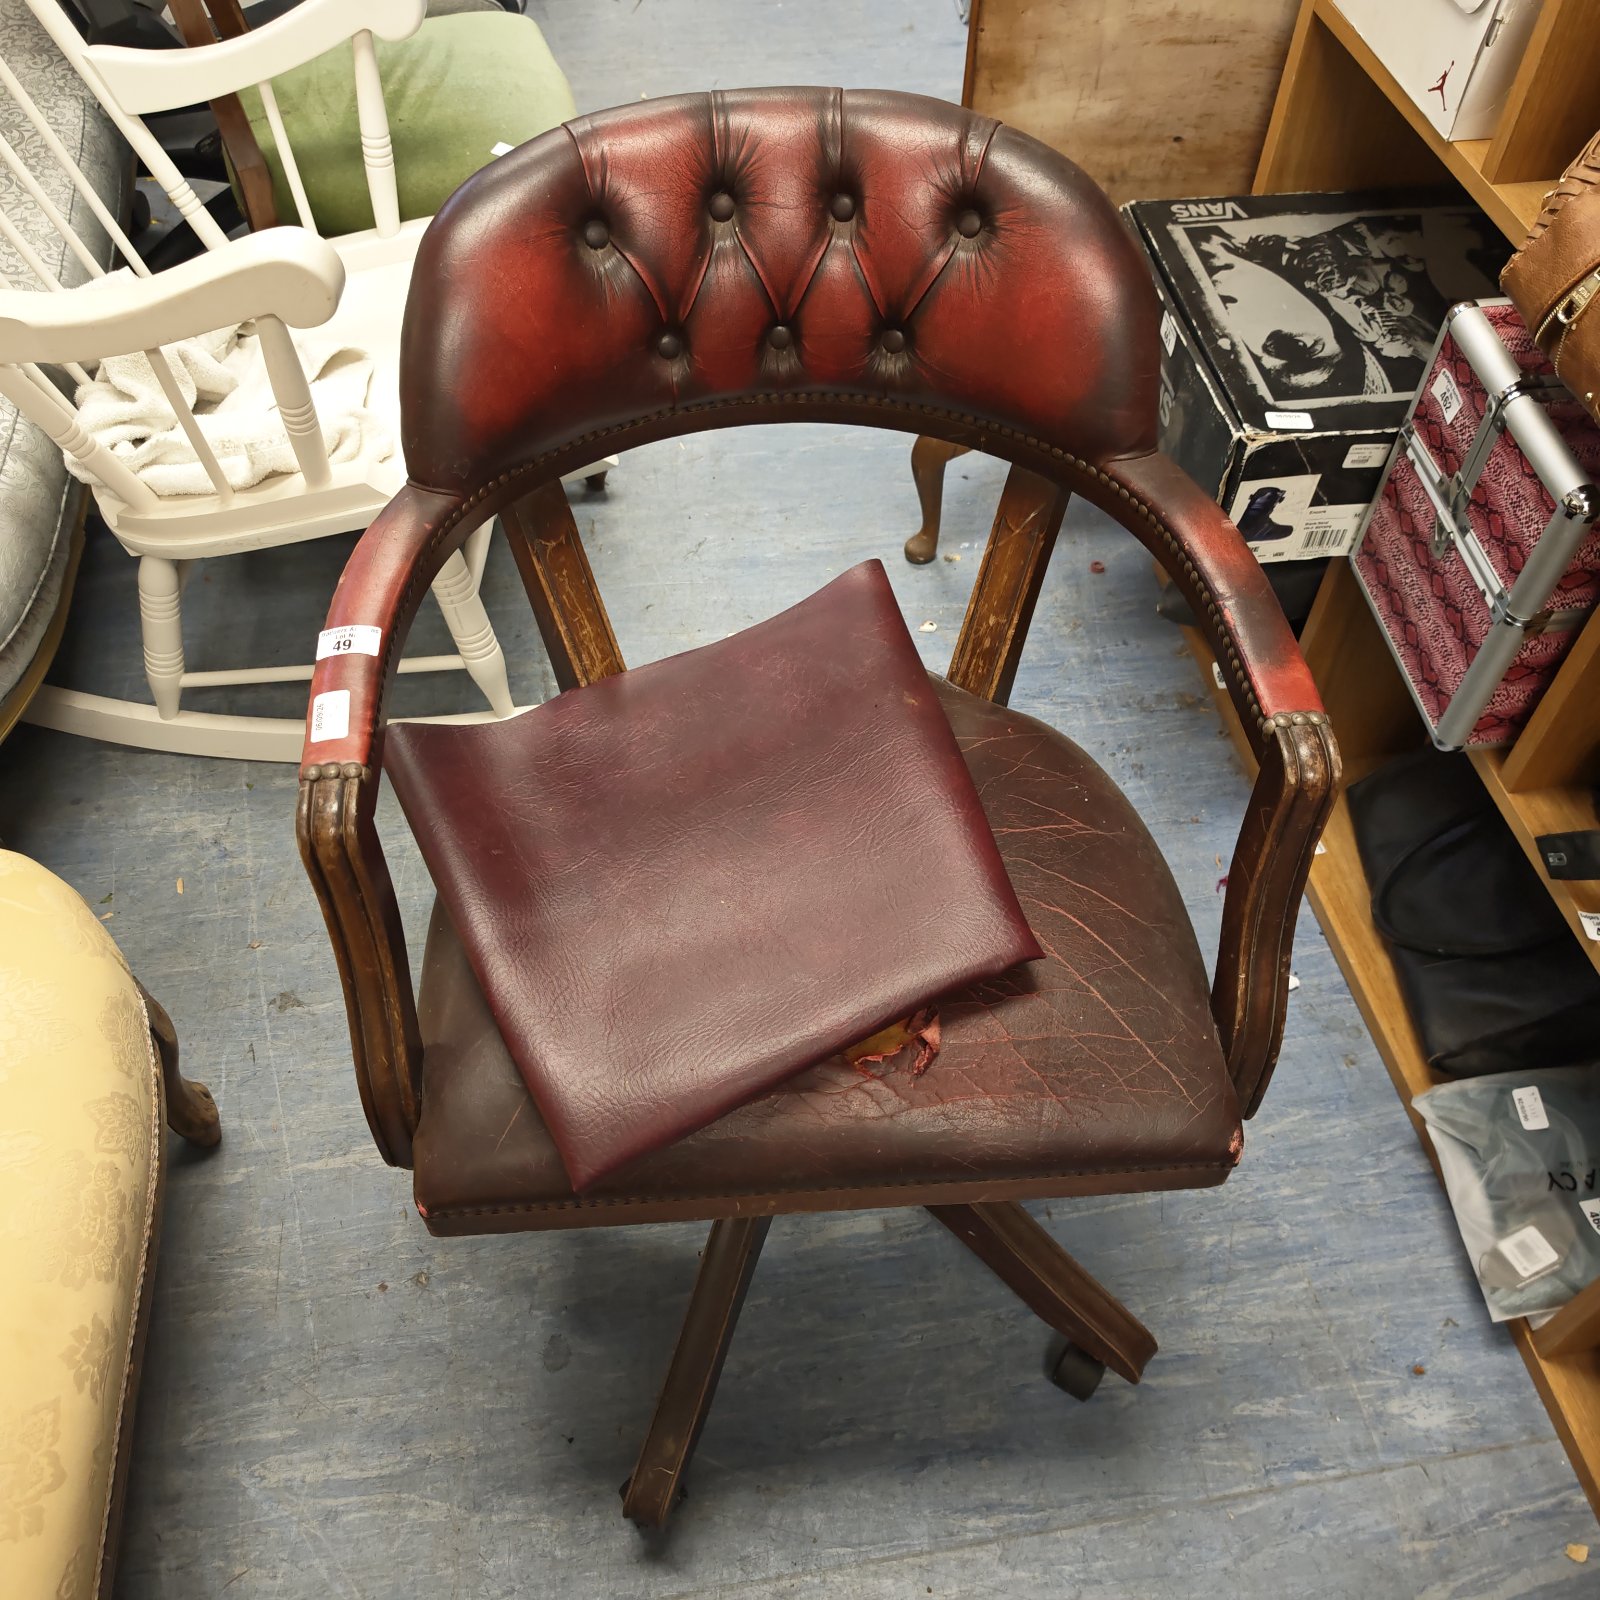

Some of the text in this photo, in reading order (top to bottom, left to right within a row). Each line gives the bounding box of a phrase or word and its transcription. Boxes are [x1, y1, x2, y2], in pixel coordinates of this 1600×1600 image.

[1170, 201, 1249, 222] VANS
[1440, 391, 1452, 414] 462
[332, 639, 352, 651] 49
